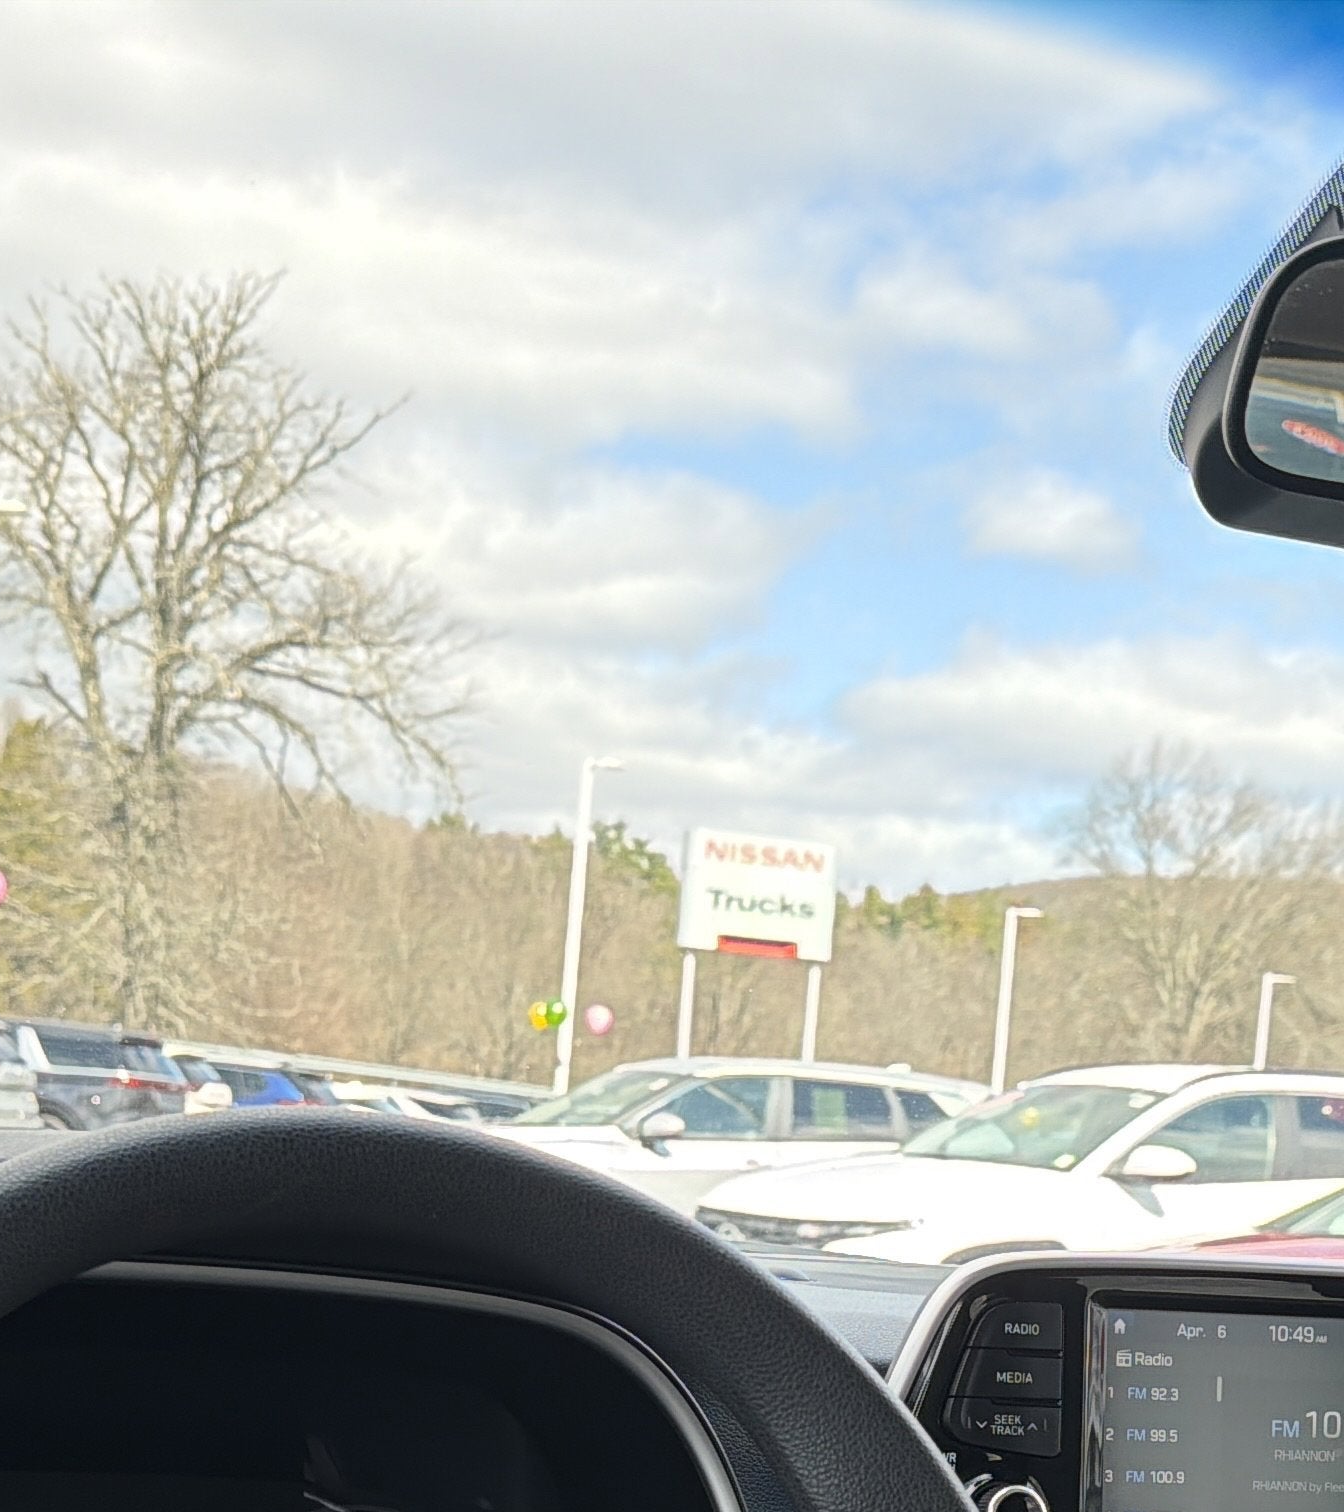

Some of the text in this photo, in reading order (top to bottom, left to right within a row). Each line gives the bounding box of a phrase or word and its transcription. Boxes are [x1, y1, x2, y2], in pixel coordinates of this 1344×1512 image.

[704, 838, 825, 873] NISSAN
[707, 886, 817, 920] Trucks
[1004, 1322, 1040, 1336] RADIO
[1217, 1325, 1228, 1339] 6
[1268, 1325, 1315, 1344] 10:49
[1134, 1351, 1173, 1367] Radio
[996, 1371, 1034, 1384] MEDIA
[1107, 1386, 1179, 1401] 1 FM 92.3
[994, 1414, 1022, 1425] SEEK
[991, 1424, 1024, 1436] TRACK
[1105, 1428, 1178, 1442] 2 FM 99.5
[1271, 1420, 1300, 1438] FM
[1274, 1450, 1335, 1462] RHIANNON
[1104, 1470, 1185, 1484] 3 FM 100.9
[1252, 1481, 1306, 1492] RHIANNON
[1309, 1482, 1322, 1494] by
